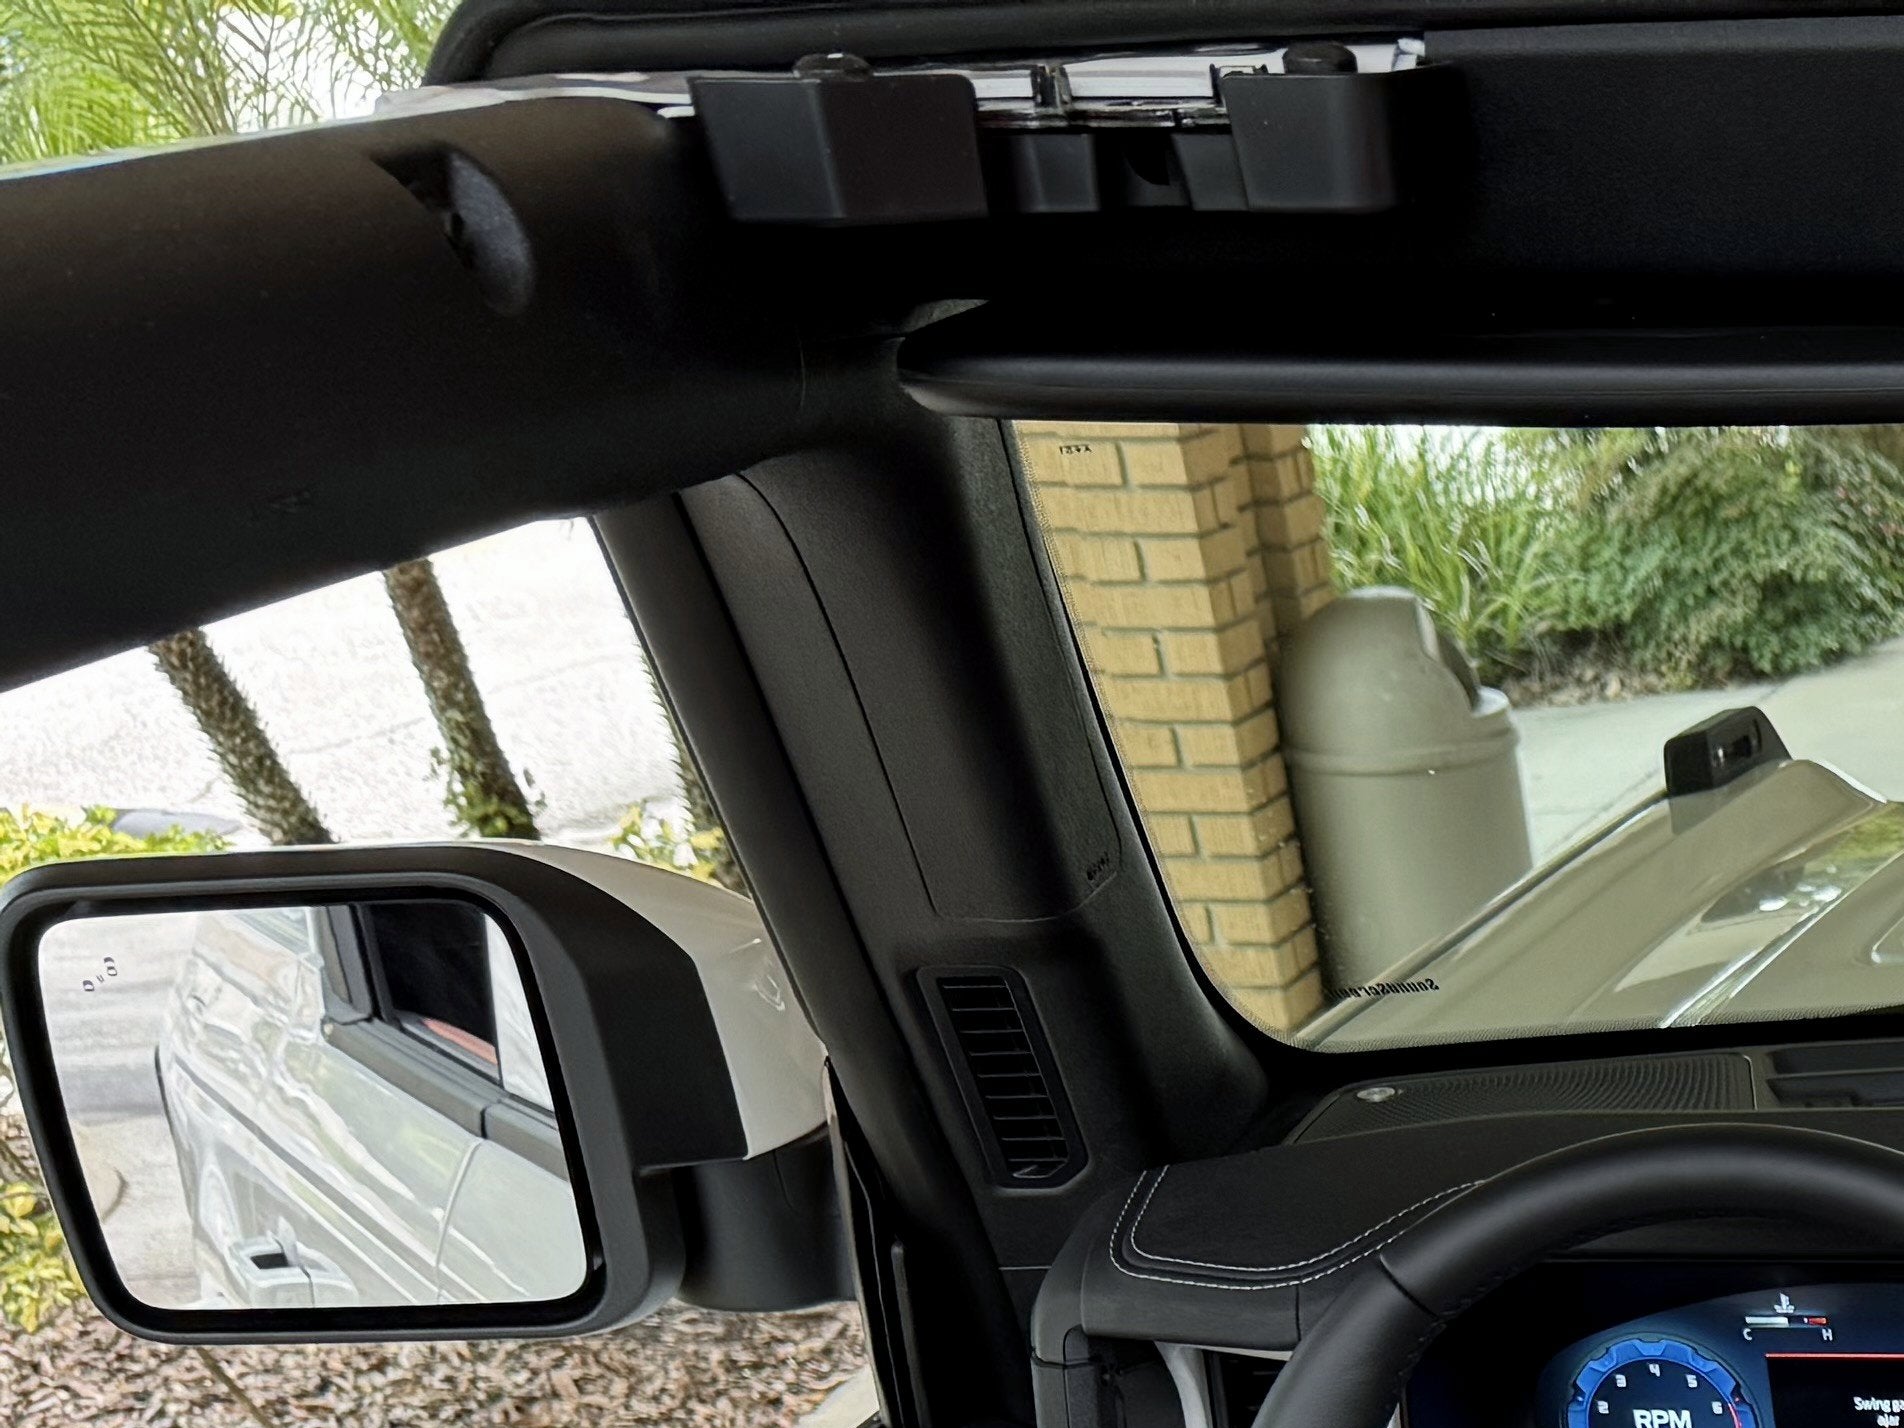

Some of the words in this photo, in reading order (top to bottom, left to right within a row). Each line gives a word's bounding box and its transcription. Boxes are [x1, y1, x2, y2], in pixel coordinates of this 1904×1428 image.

[1743, 1329, 1752, 1340] C
[1822, 1329, 1833, 1341] H
[1649, 1363, 1660, 1377] 4
[1616, 1374, 1627, 1387] 3
[1687, 1374, 1697, 1388] 5
[1598, 1400, 1609, 1414] 2
[1712, 1401, 1723, 1414] 6
[1854, 1397, 1891, 1412] Swing
[1877, 1414, 1900, 1428] ajar
